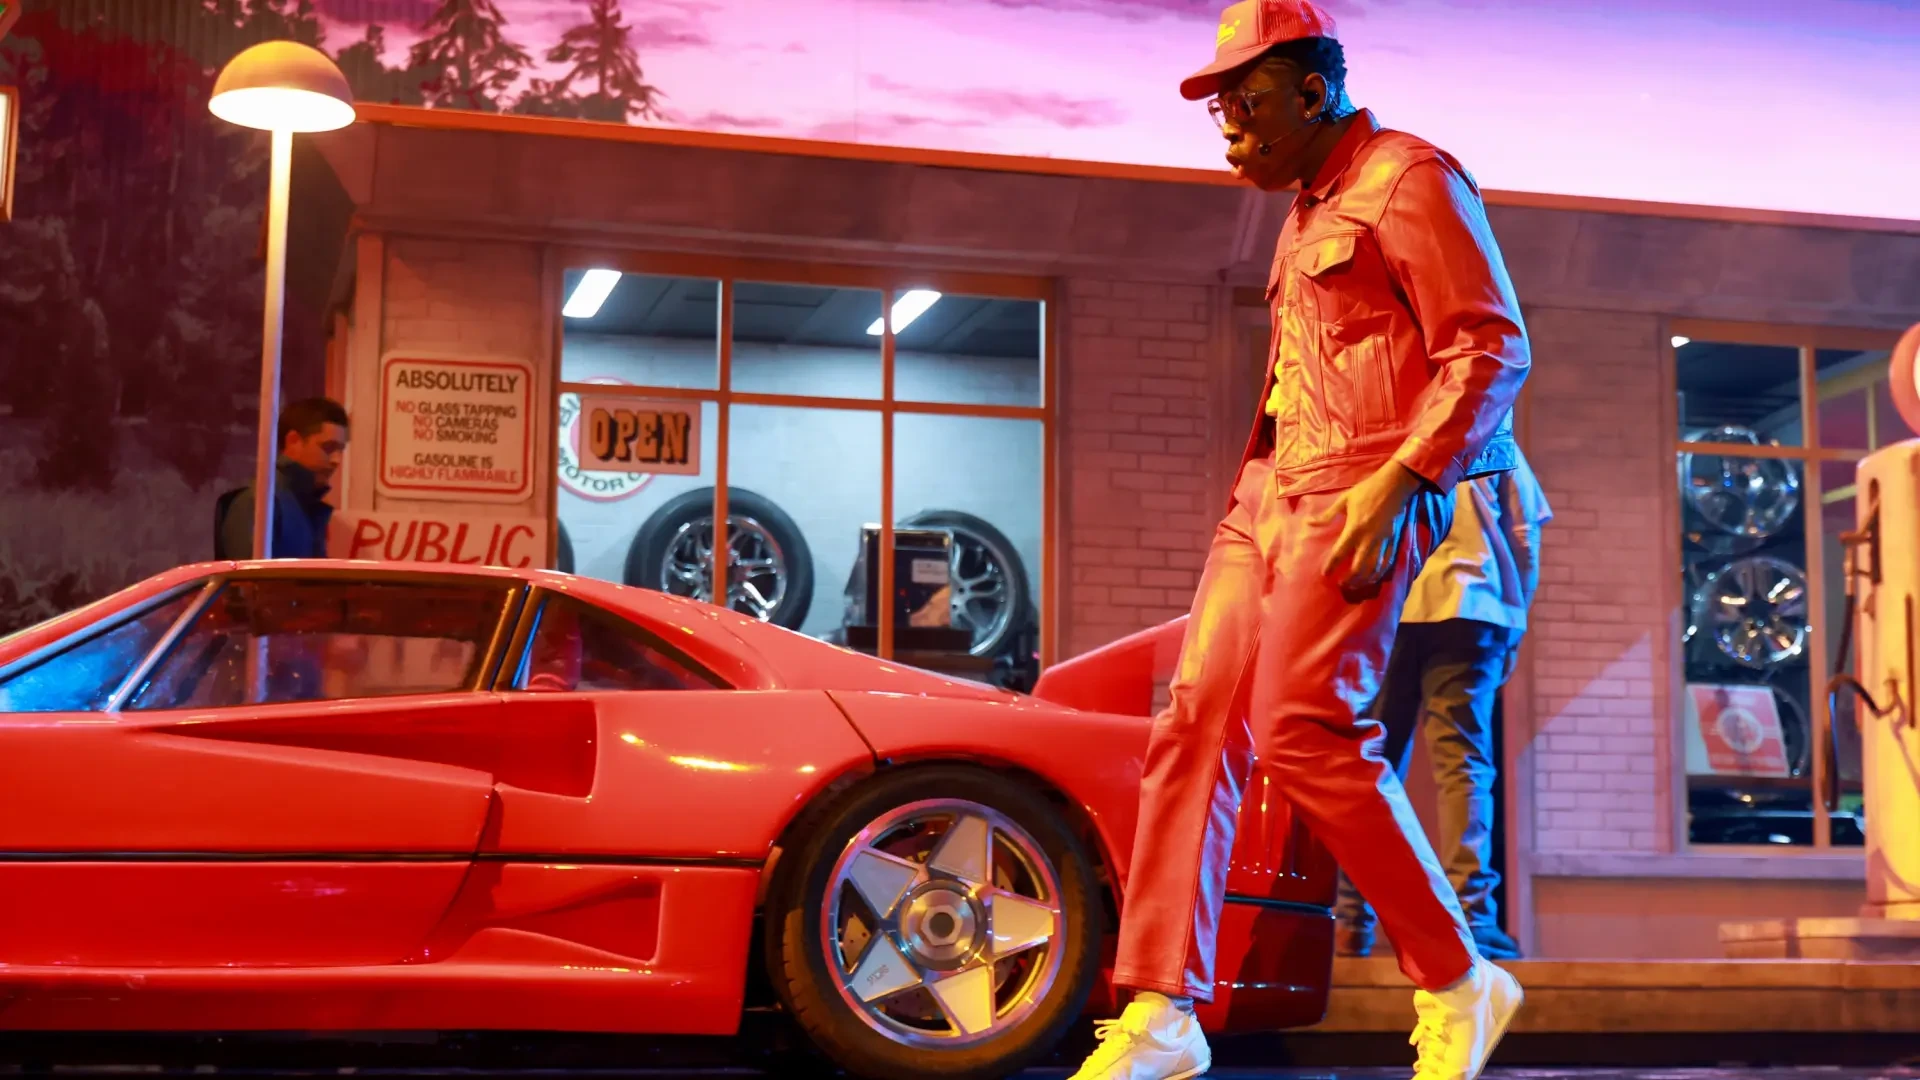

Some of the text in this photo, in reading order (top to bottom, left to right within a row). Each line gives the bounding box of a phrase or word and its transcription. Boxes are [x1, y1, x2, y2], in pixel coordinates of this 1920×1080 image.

[396, 369, 518, 393] ABSOLUTELY
[395, 400, 517, 419] NO GLASS TAPPING
[413, 414, 499, 432] NO CAMERAS
[413, 428, 498, 445] NO SMOKING
[590, 407, 691, 465] OPEN
[414, 453, 494, 469] GASOLINE IS
[390, 465, 518, 483] HIGHLY FLAMMABLE
[350, 518, 535, 568] PUBLIC
